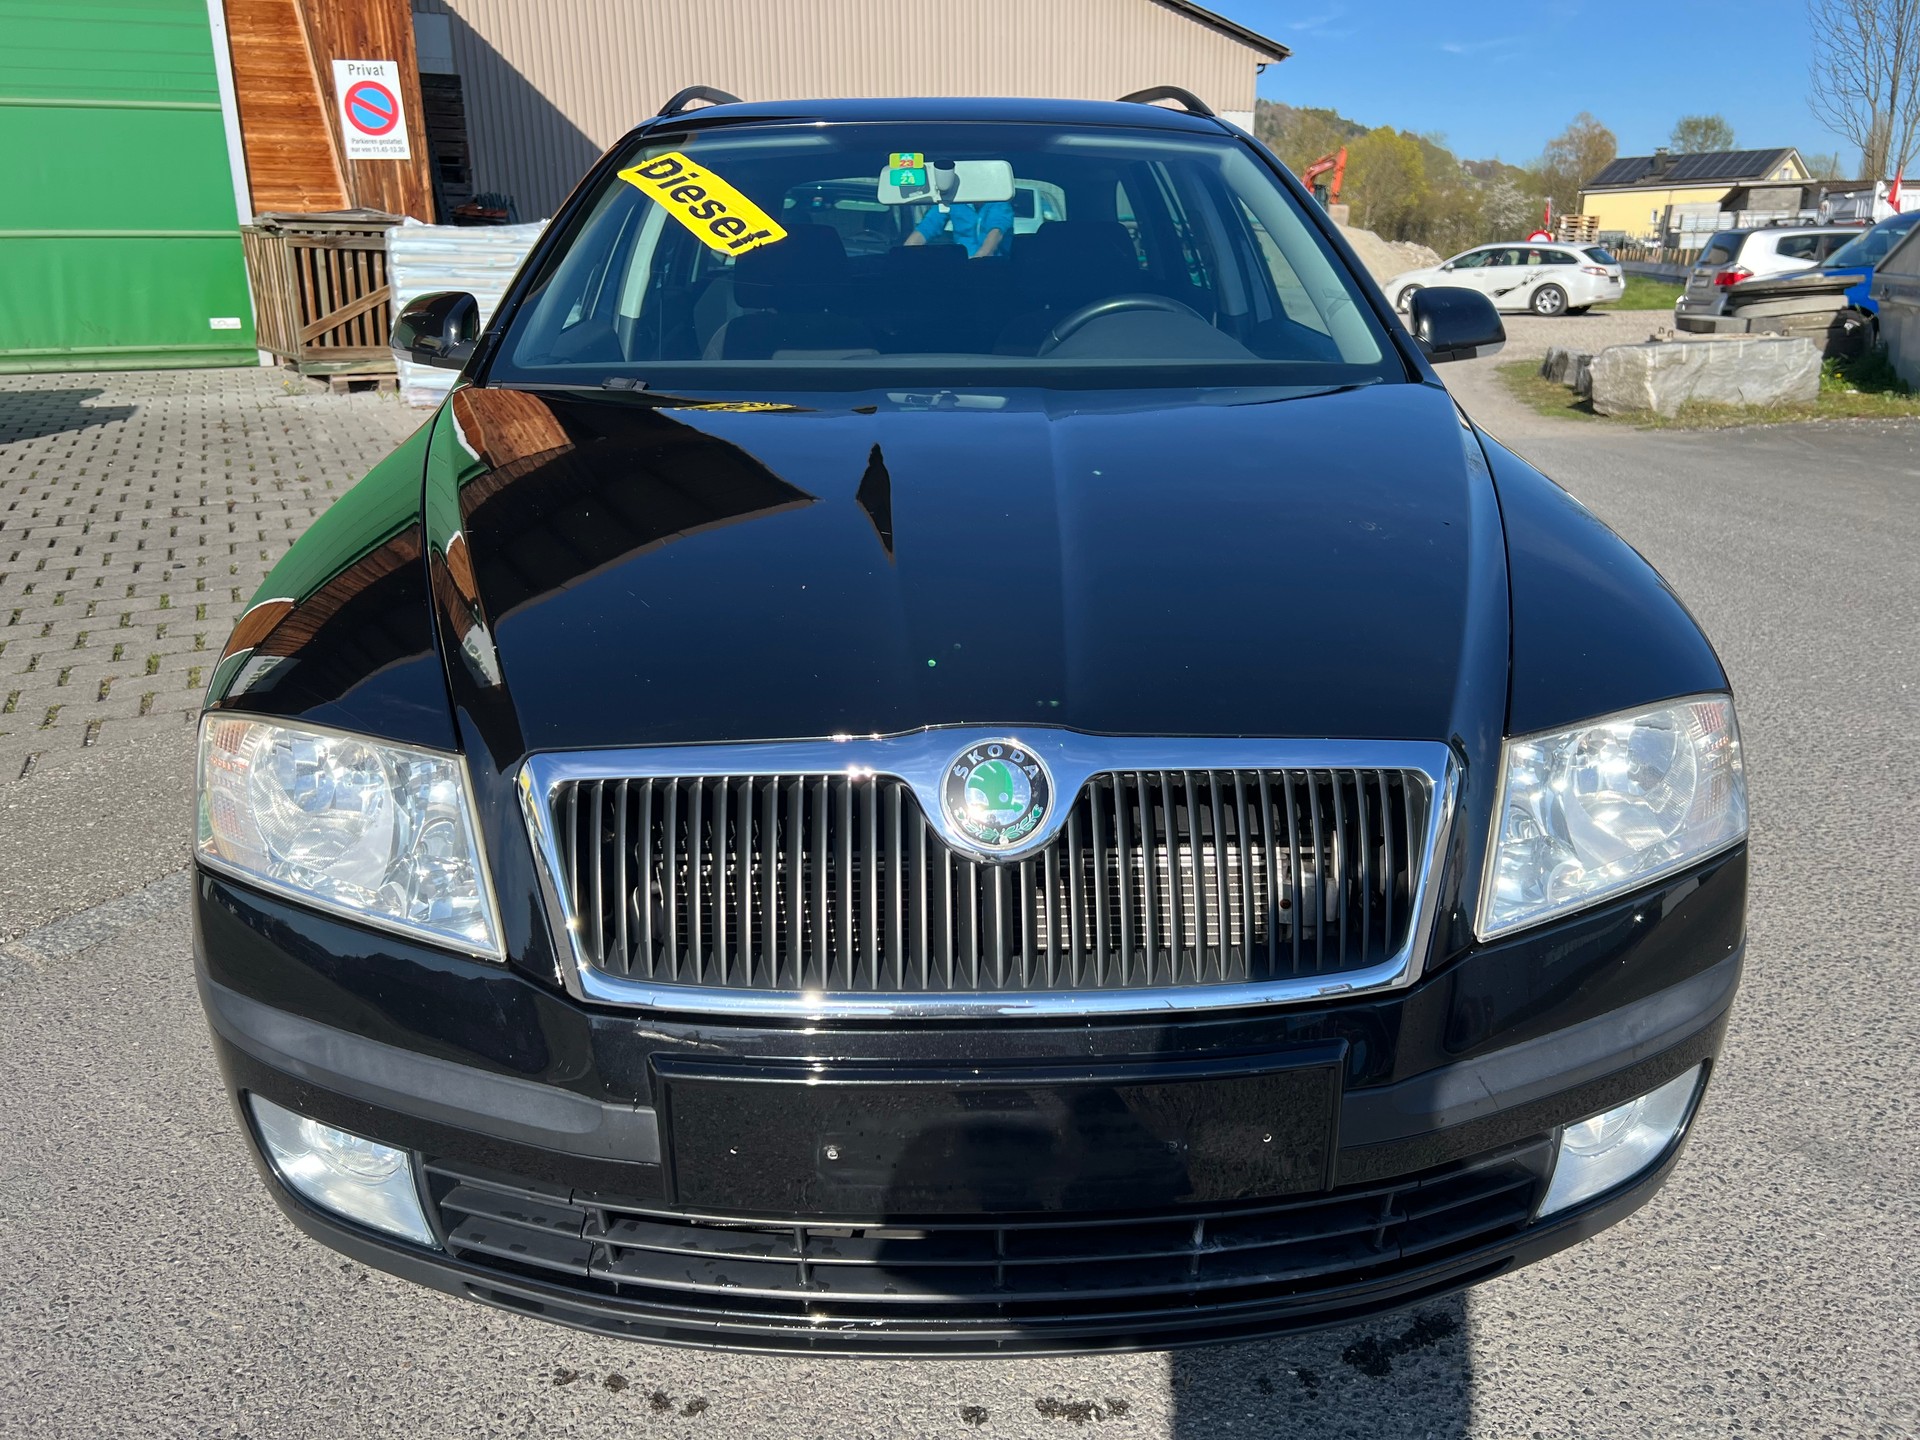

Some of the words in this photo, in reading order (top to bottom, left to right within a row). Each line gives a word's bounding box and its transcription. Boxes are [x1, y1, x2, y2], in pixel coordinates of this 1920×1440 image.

[347, 63, 385, 76] Privat
[351, 137, 377, 145] Parkieren
[635, 157, 773, 250] Diesel
